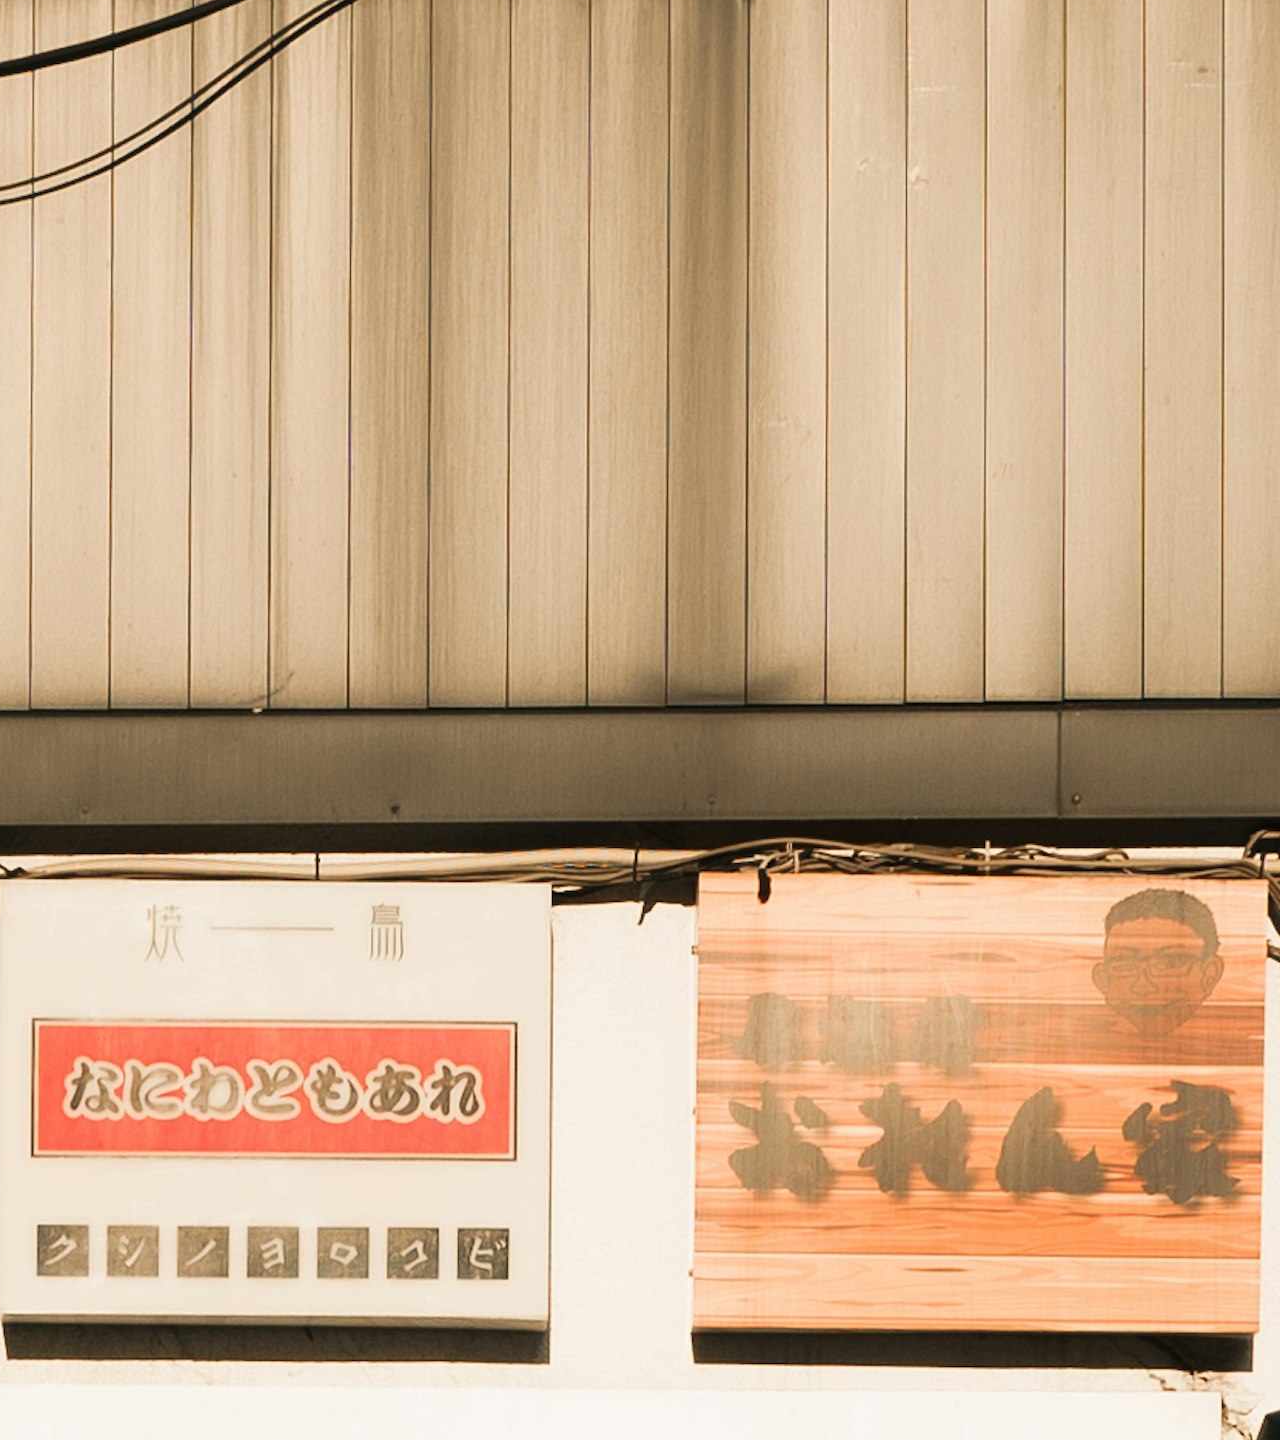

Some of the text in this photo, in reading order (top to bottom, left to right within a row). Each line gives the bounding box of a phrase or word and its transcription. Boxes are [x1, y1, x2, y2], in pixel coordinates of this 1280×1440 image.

[65, 1058, 485, 1121] なにわともあれ
